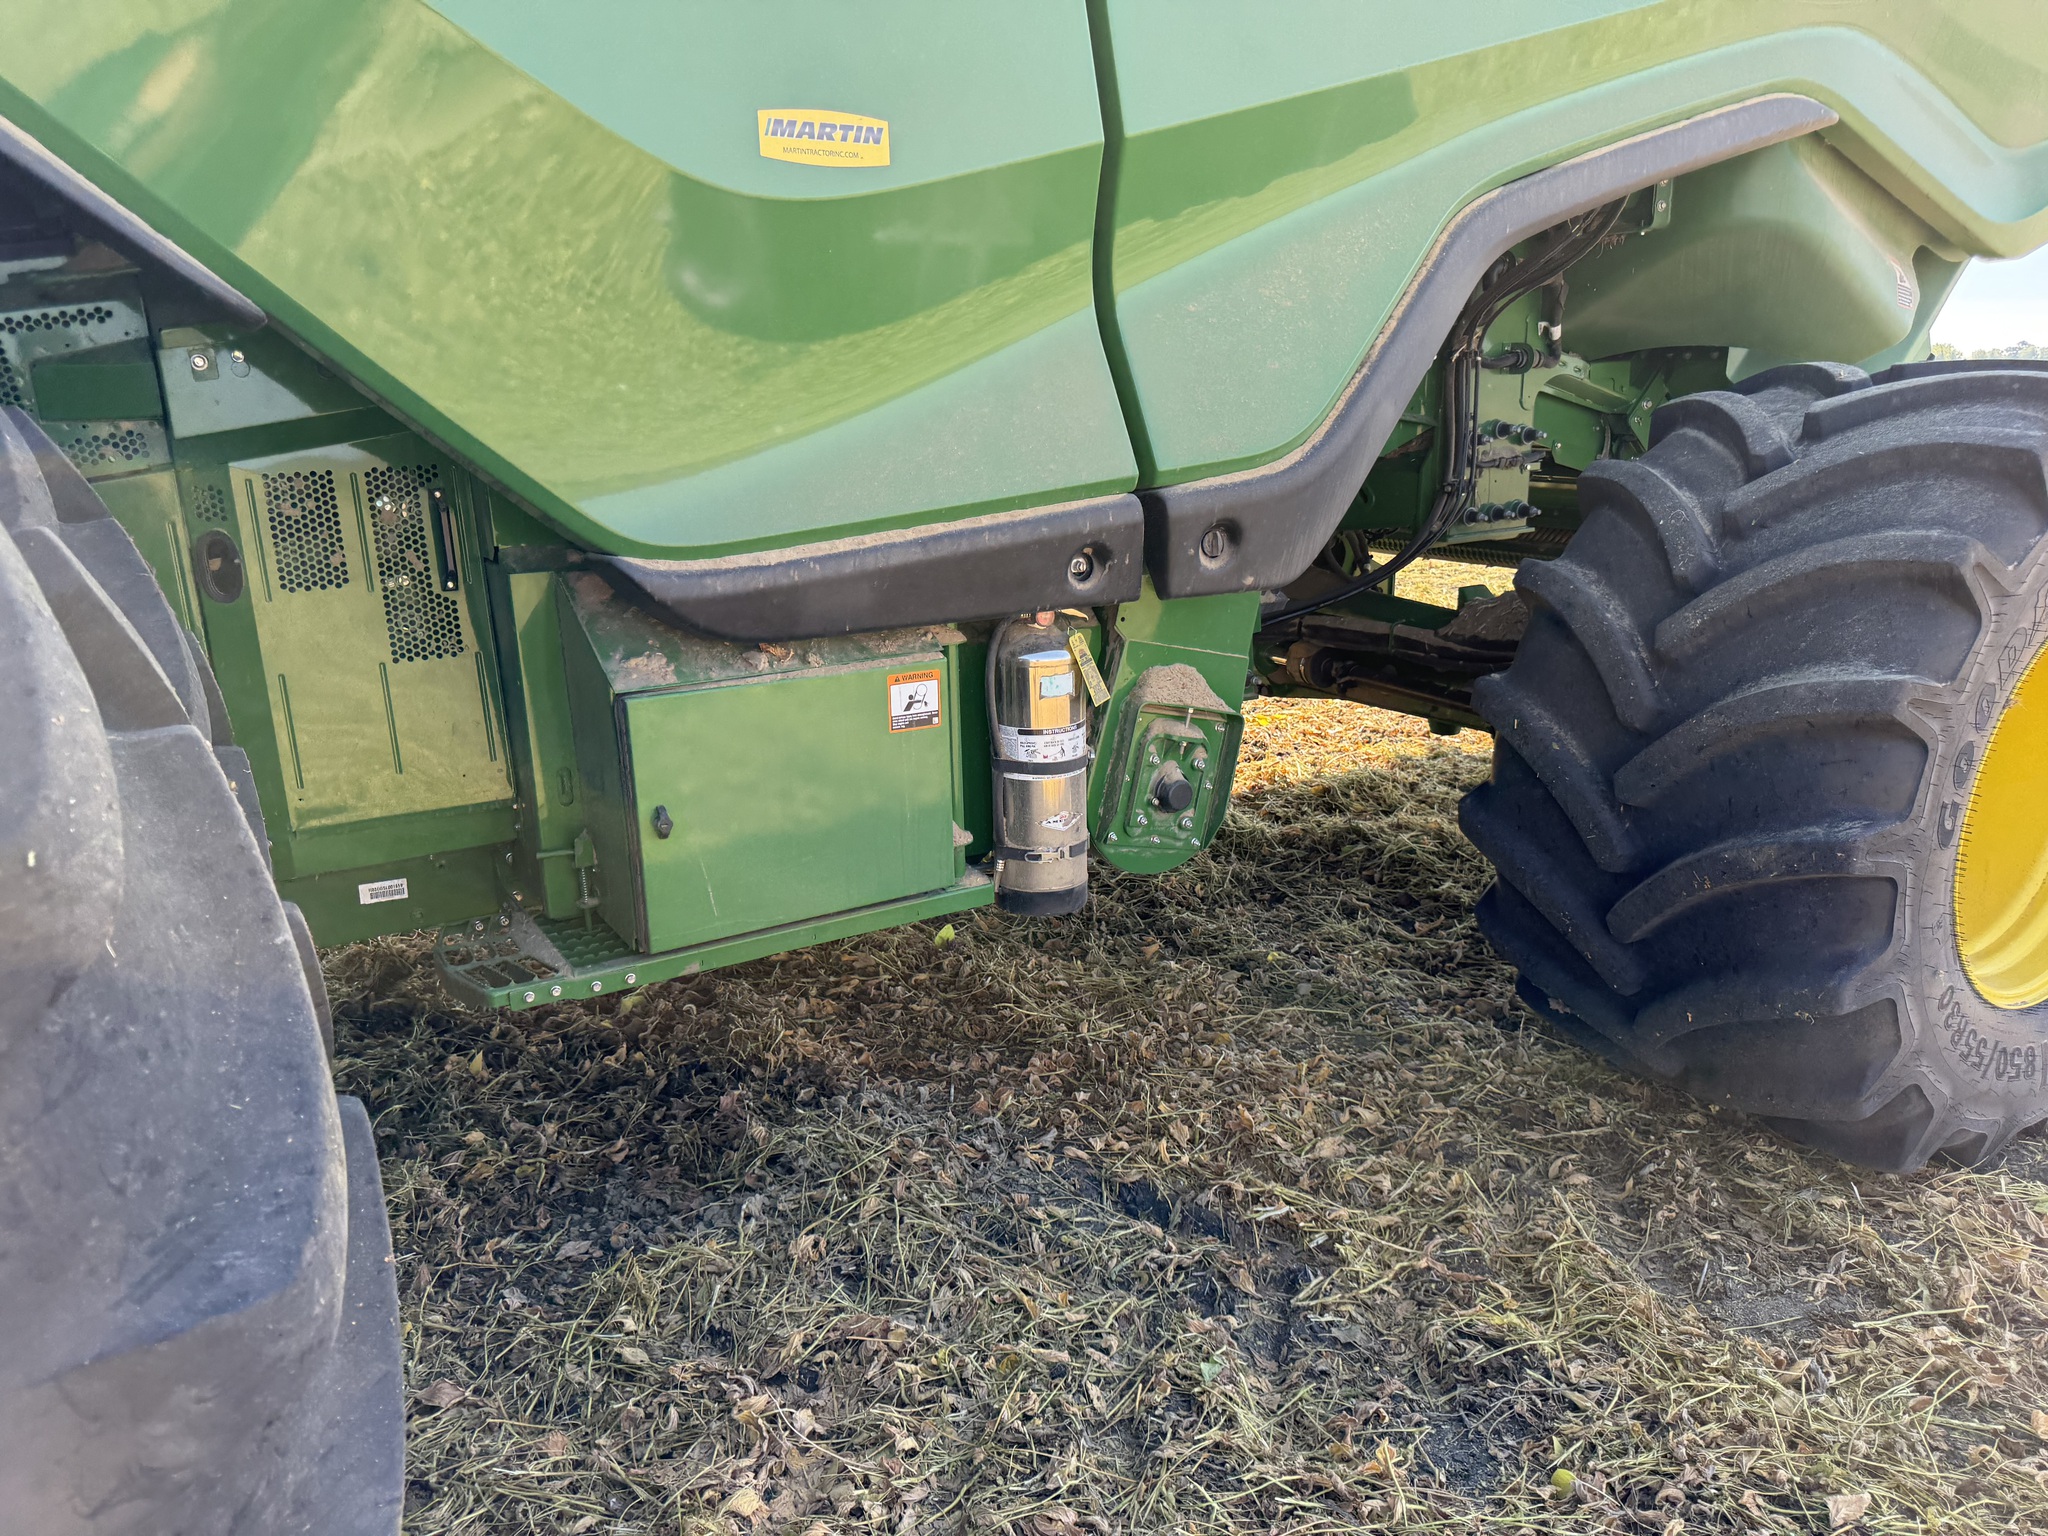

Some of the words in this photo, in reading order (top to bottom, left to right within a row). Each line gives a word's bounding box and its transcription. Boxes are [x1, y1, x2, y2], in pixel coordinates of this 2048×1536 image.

[769, 118, 884, 145] MARTIN
[782, 147, 859, 159] MARTINTRACTORINC.COM
[901, 672, 934, 681] WARNING
[1042, 725, 1078, 735] INSTRUCTIONS
[1937, 984, 2037, 1082] 850/55R30
